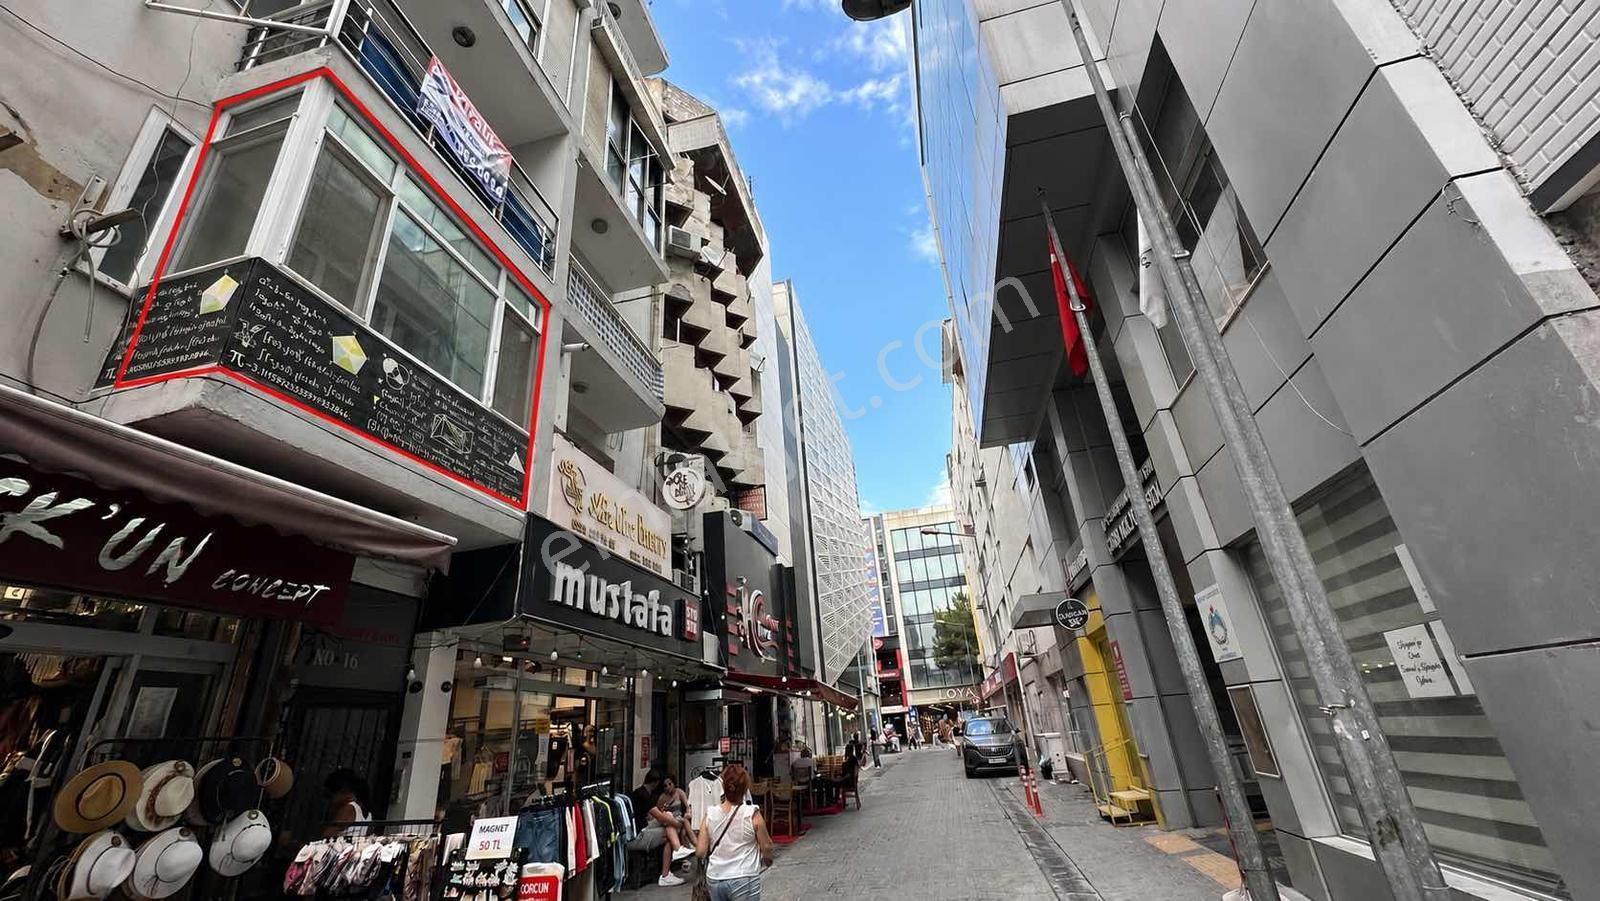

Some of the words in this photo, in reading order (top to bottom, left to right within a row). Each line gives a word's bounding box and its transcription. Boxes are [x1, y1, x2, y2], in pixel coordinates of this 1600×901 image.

[211, 568, 331, 607] CONCEPT
[550, 561, 674, 637] mustafa
[312, 648, 336, 666] NO
[343, 652, 359, 670] 16
[479, 824, 510, 834] MAGNET
[479, 841, 490, 850] 50
[491, 840, 501, 850] TL
